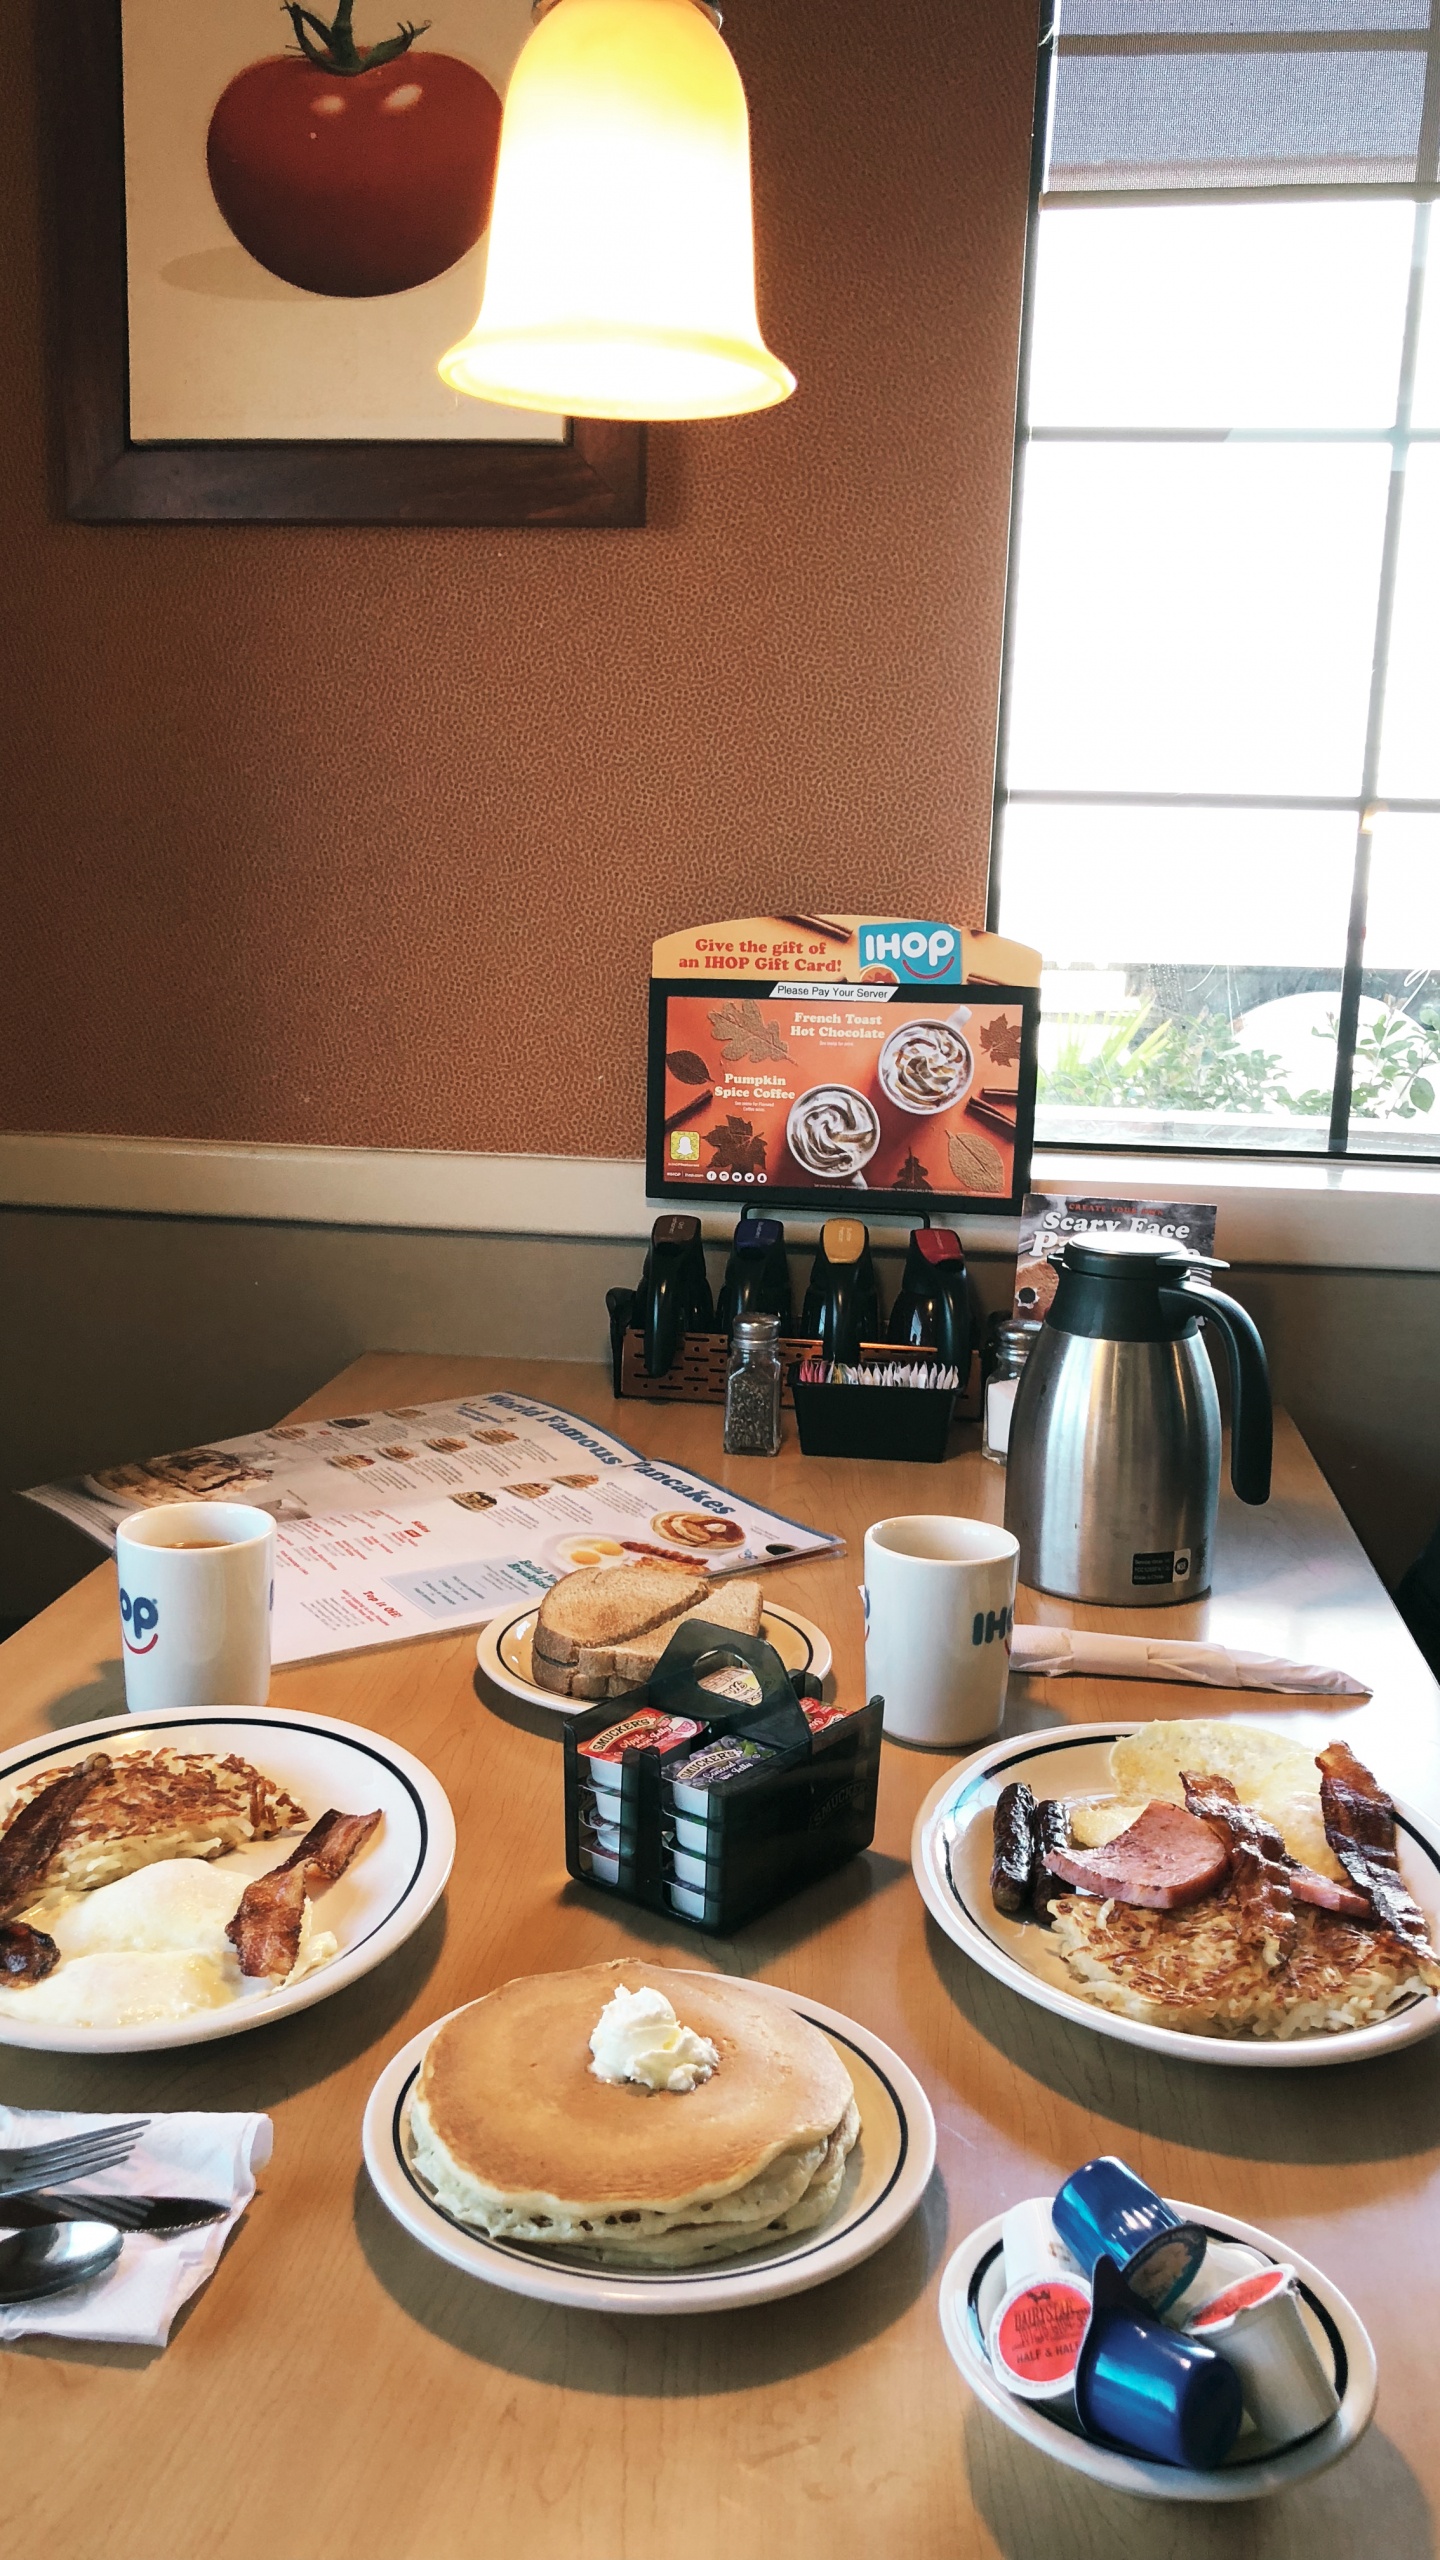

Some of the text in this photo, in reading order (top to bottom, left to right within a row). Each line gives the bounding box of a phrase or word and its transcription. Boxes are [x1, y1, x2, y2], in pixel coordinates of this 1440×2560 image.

[695, 938, 827, 957] Give the gift of
[865, 930, 955, 967] IHOP
[678, 956, 842, 972] an IHOP Gift Card!
[777, 985, 888, 999] Please Pay Your Server
[794, 1011, 882, 1025] French Toast
[790, 1025, 885, 1039] Hot Chocolate
[724, 1073, 786, 1087] Pumpkin
[714, 1086, 796, 1099] Spice Coffee
[1068, 1203, 1106, 1213] CREATE
[1110, 1206, 1137, 1215] YOUR
[1042, 1211, 1190, 1239] Scary Face
[483, 1394, 549, 1417] World
[537, 1414, 623, 1465] Famous
[621, 1460, 738, 1516] Pancakes
[362, 1590, 379, 1602] Top
[593, 1718, 651, 1751] SMUCKER'S
[650, 1726, 672, 1740] Jelly
[620, 1733, 647, 1748] Apple
[680, 1751, 738, 1779] SMUCKER'S
[731, 1762, 753, 1774] Jelly
[1017, 2349, 1041, 2363] HALF
[1045, 2348, 1052, 2358] &
